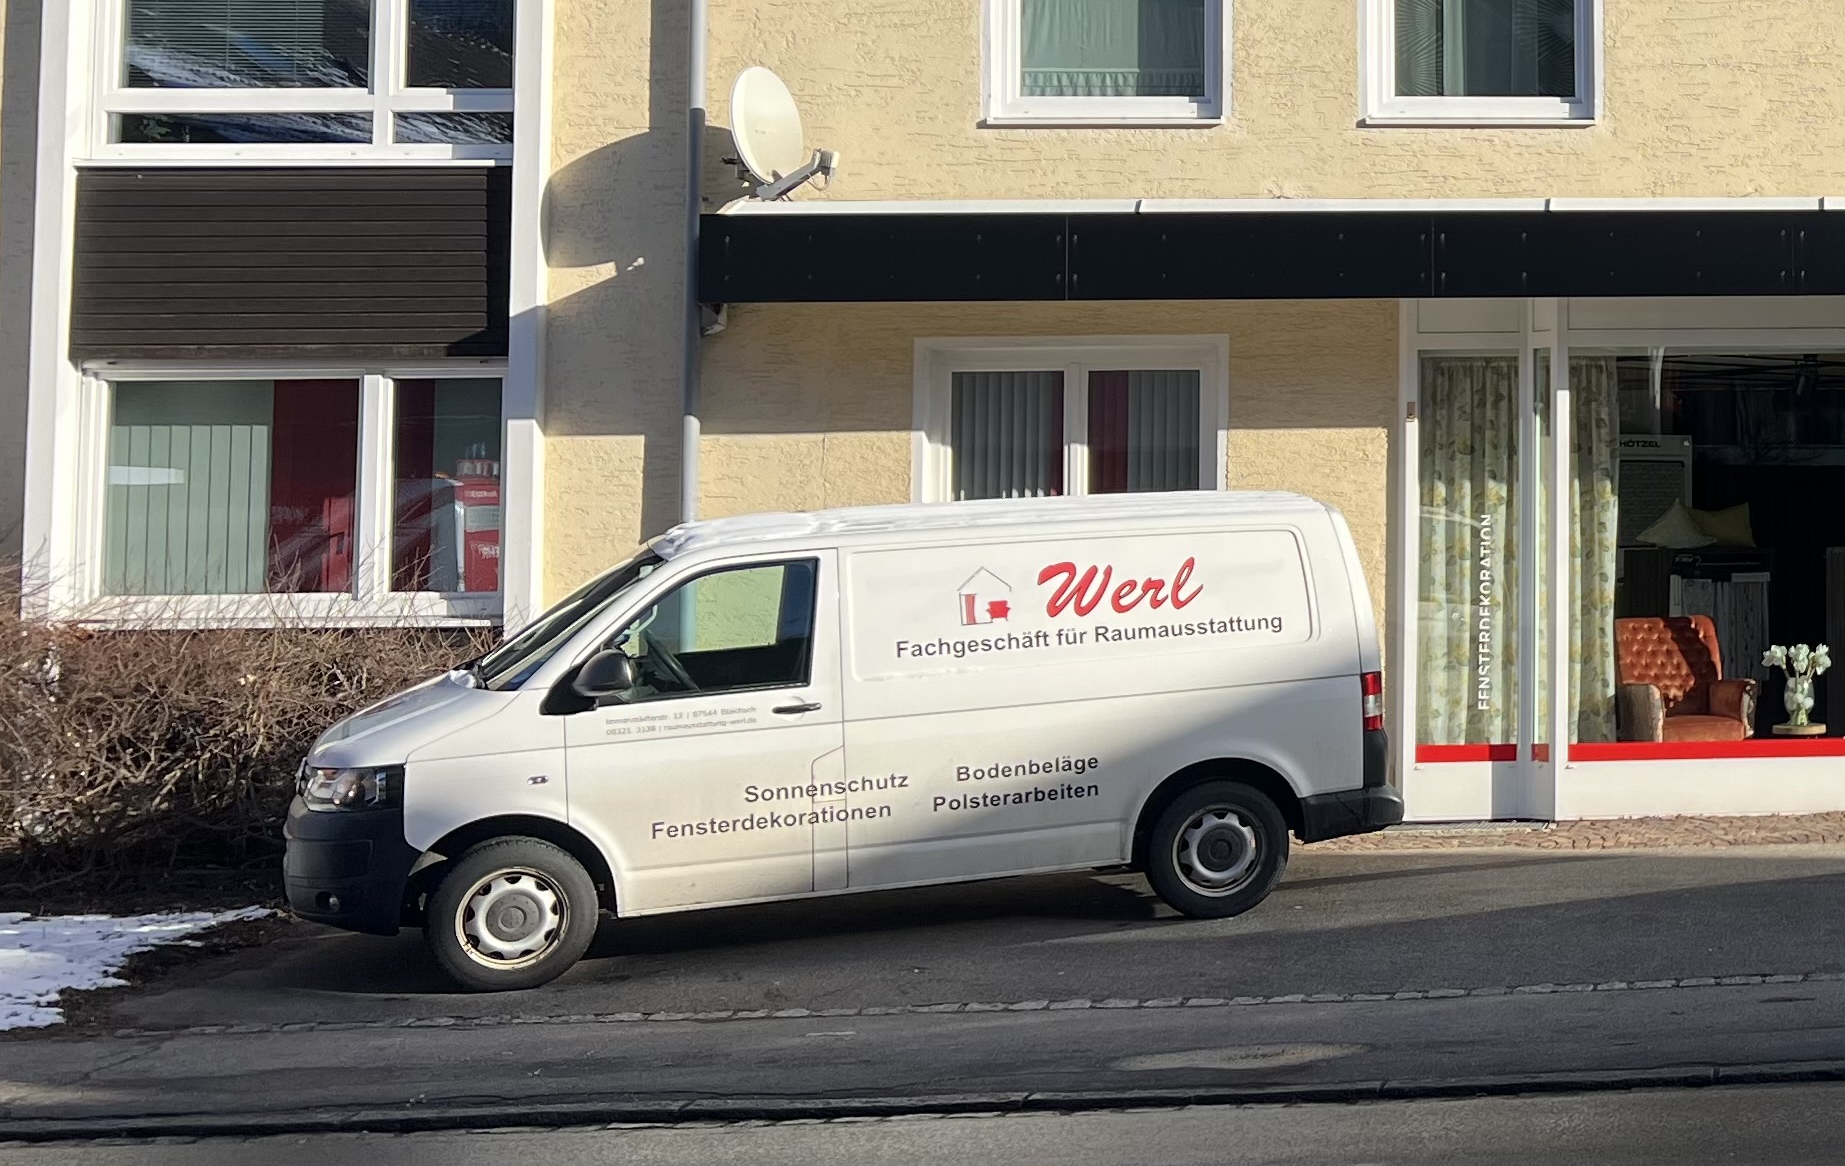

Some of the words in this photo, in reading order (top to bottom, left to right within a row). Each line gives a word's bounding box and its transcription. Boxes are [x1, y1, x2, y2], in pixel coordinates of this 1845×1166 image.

[1037, 556, 1204, 618] Werl
[895, 627, 1050, 659] Fachgeschäft
[1057, 627, 1088, 646] für
[1095, 614, 1284, 643] Raumausstattung
[956, 755, 1100, 783] Bodenbeläge
[744, 772, 910, 803] Sonnenschutz
[933, 782, 1100, 812] Polsterarbeiten
[651, 802, 892, 840] Fensterdekorationen
